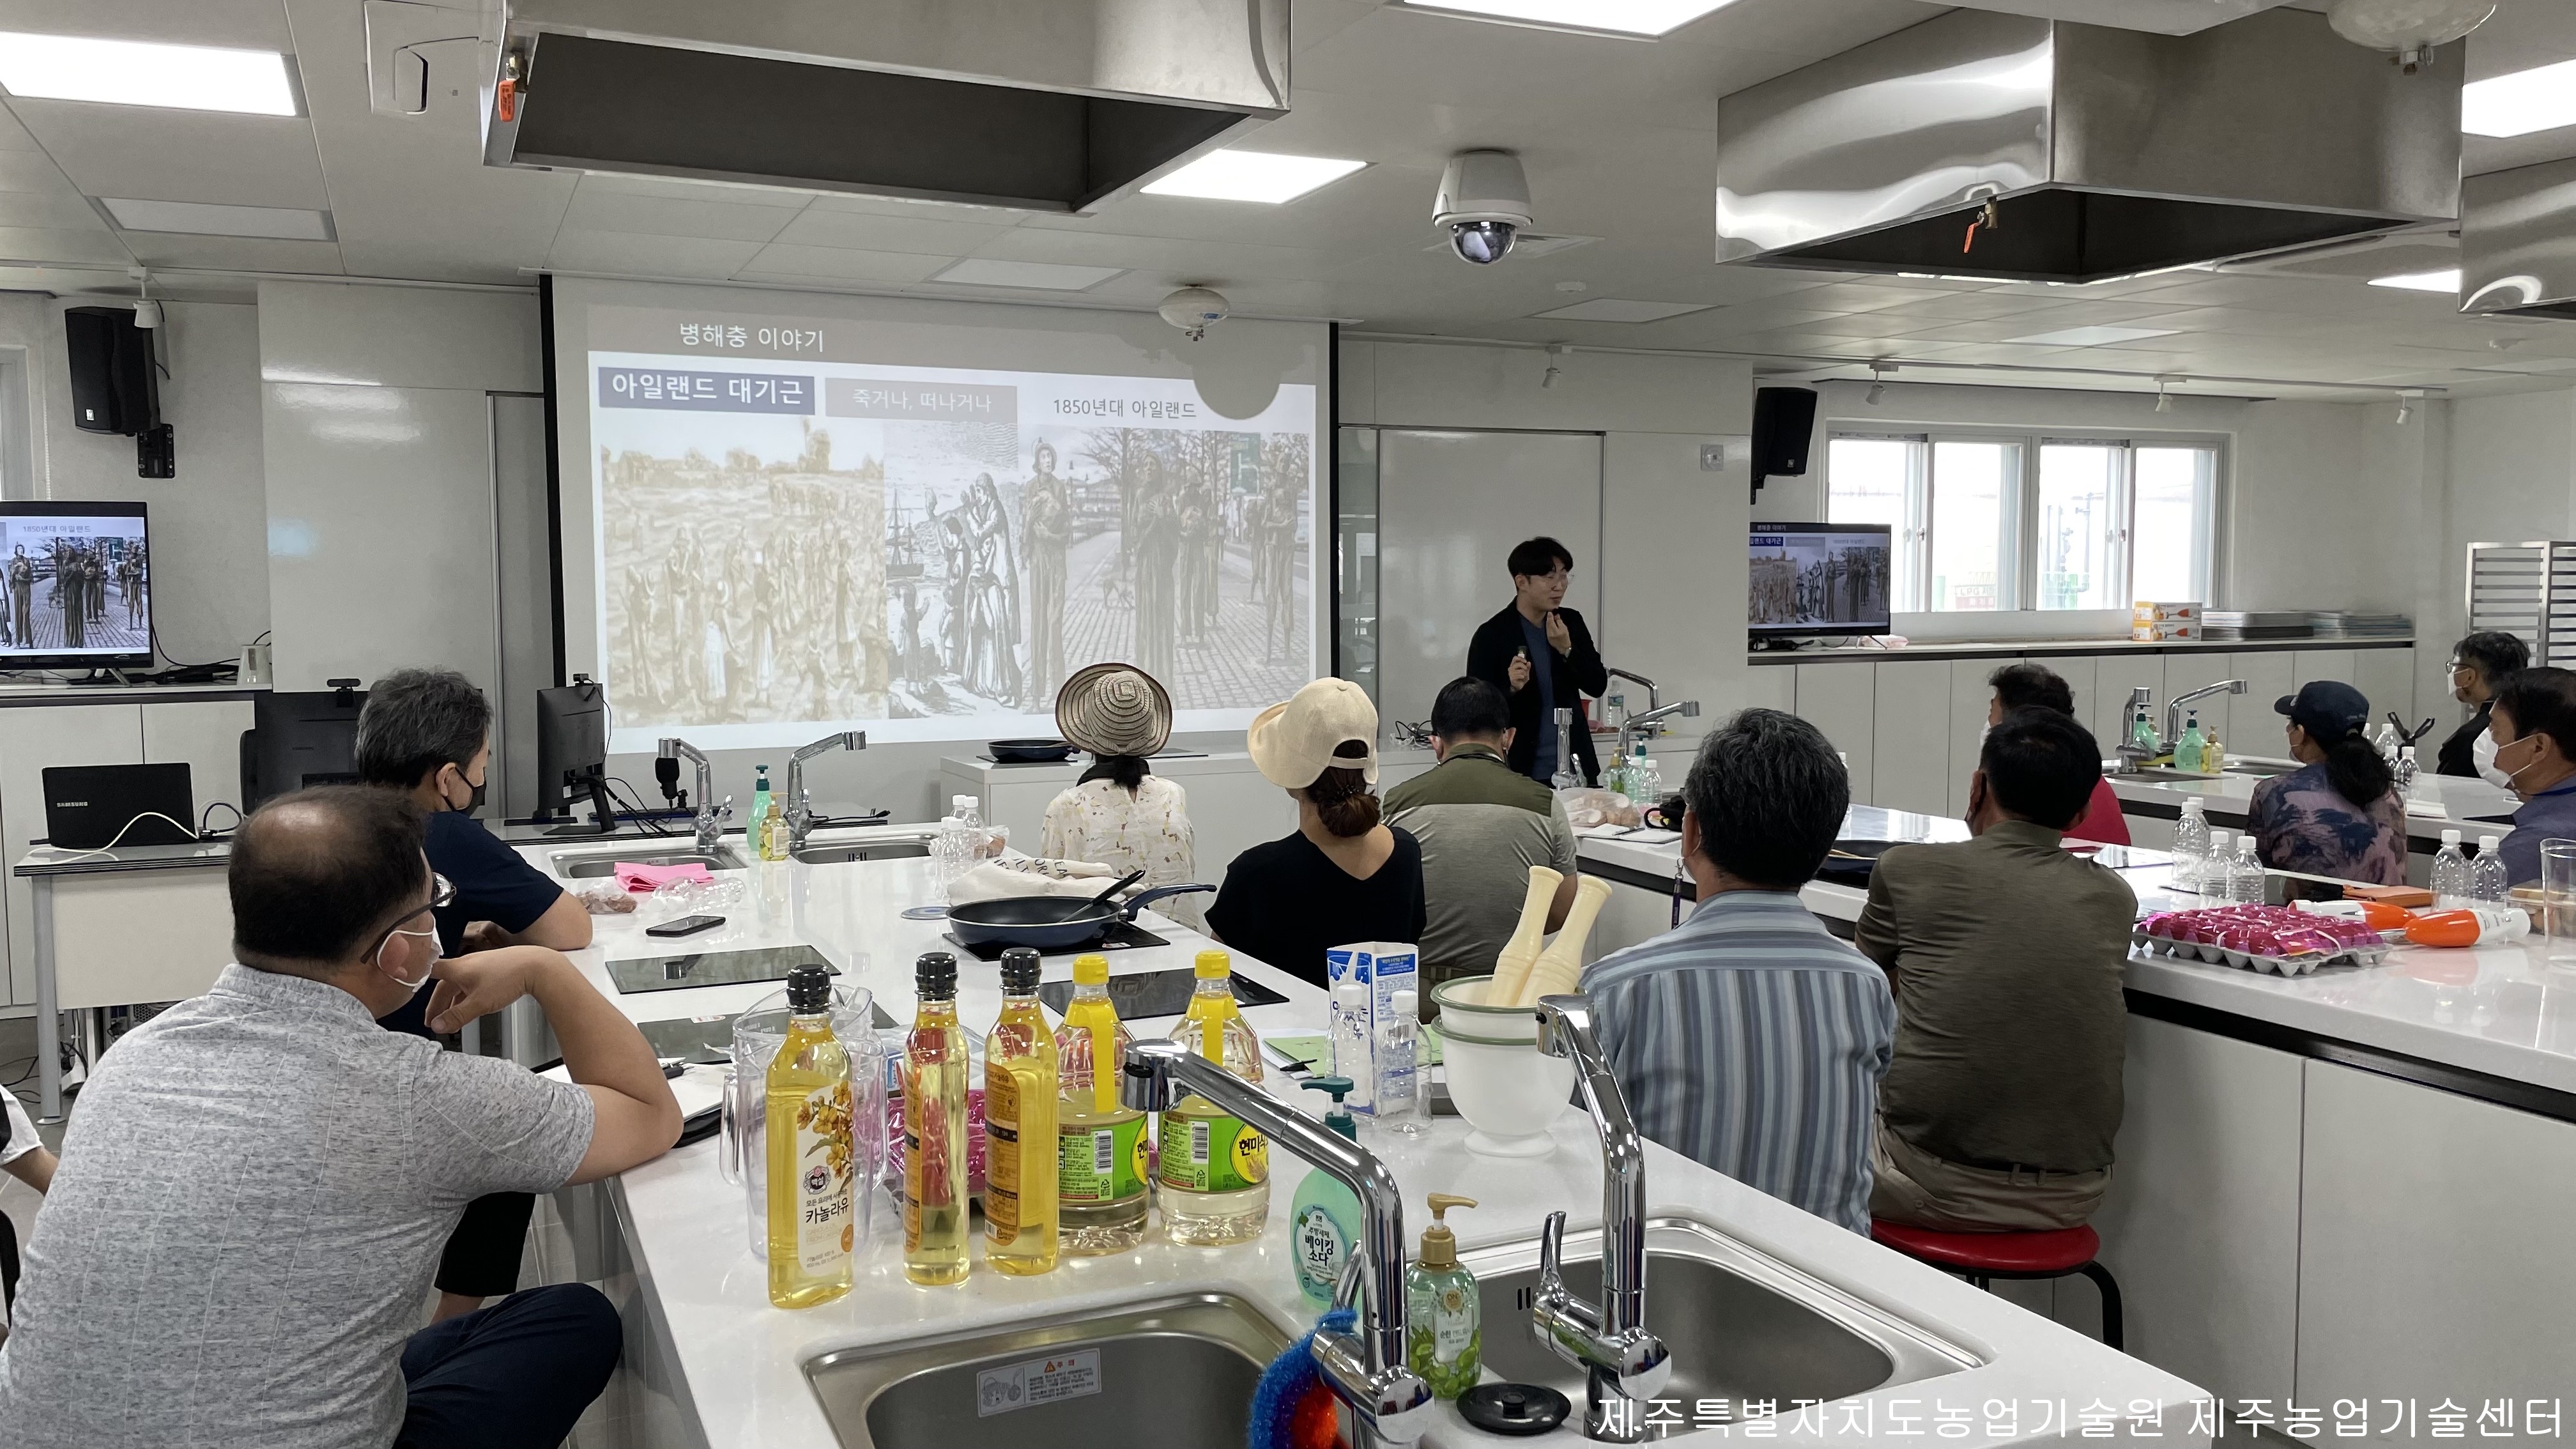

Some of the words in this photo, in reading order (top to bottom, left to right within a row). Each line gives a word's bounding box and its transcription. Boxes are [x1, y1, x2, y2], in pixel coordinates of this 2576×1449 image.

[680, 323, 748, 348] 병해충
[758, 327, 824, 353] 이야기
[612, 372, 717, 401] 아일랜드
[728, 378, 804, 404] 대기근
[852, 388, 913, 411] 죽거나,
[920, 392, 992, 413] 떠나거나
[1054, 398, 1123, 417] 1850년대
[1131, 400, 1197, 419] 아일랜드
[806, 1199, 817, 1207] 모든
[806, 1197, 849, 1225] 카놀라유
[1305, 1234, 1334, 1255] 베이킹
[1308, 1248, 1329, 1266] 소다
